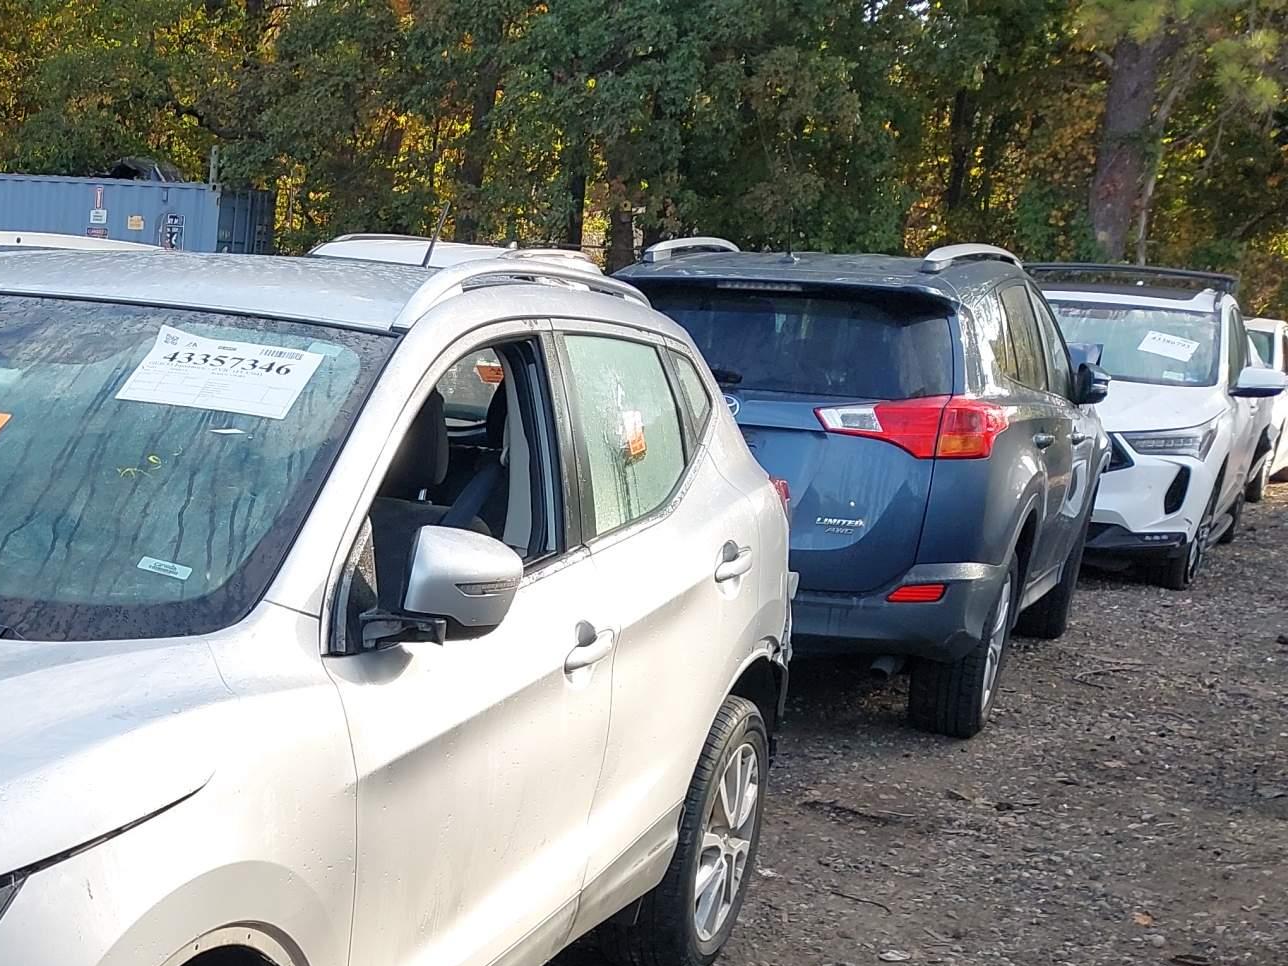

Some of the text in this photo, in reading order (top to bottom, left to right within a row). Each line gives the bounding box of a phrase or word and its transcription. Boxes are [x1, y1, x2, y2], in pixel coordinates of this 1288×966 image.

[163, 350, 293, 376] 43357346
[815, 517, 865, 527] LIMITED
[824, 527, 854, 535] AWD
